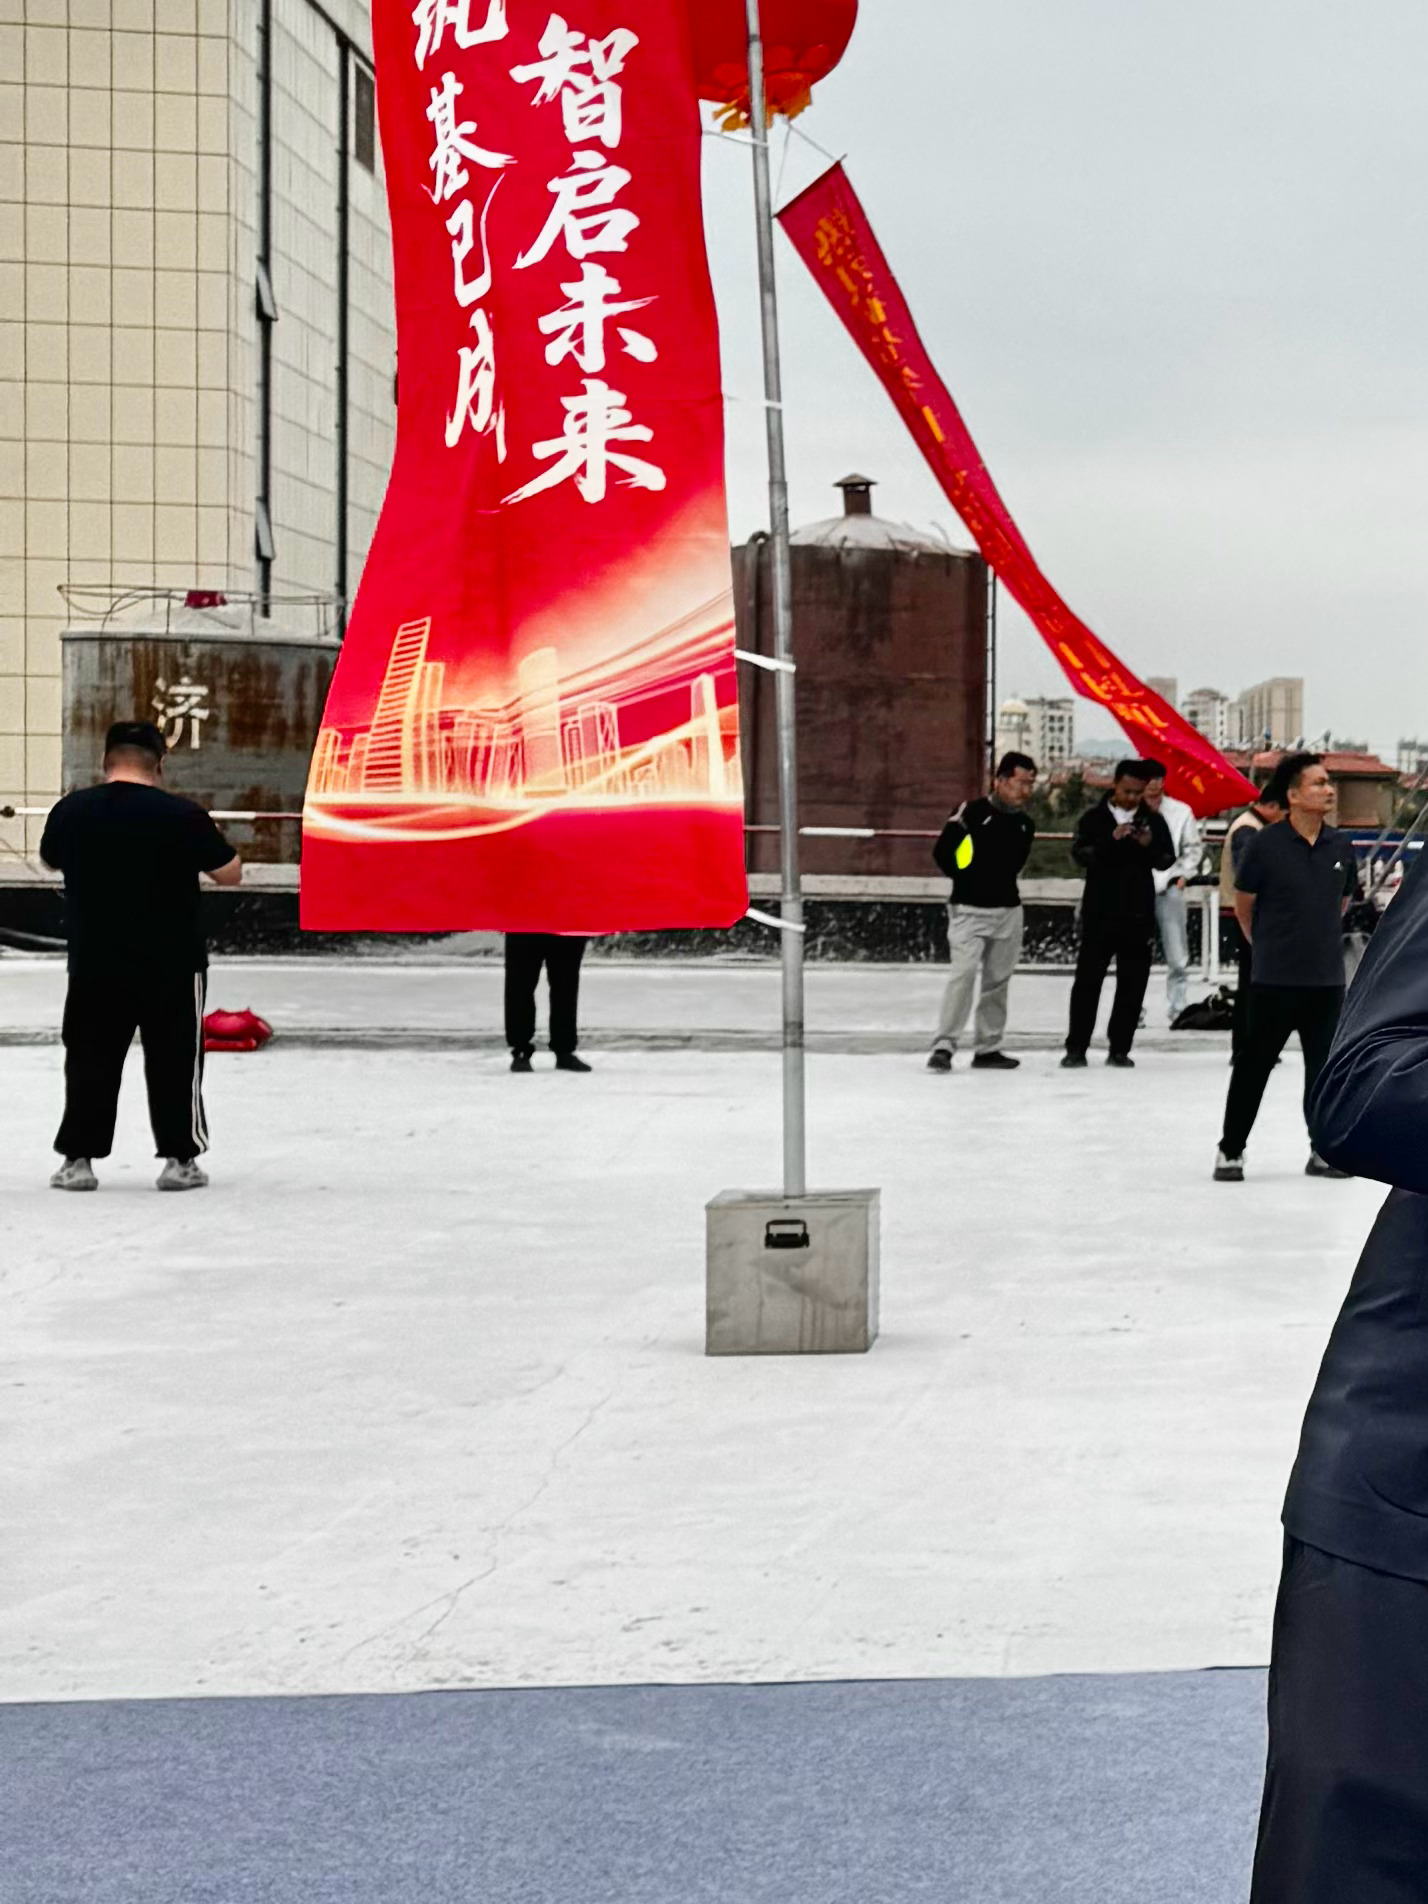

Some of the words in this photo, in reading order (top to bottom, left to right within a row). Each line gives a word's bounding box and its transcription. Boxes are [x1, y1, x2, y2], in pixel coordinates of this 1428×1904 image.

[500, 13, 667, 506] 智启未来
[151, 676, 210, 749] 济
